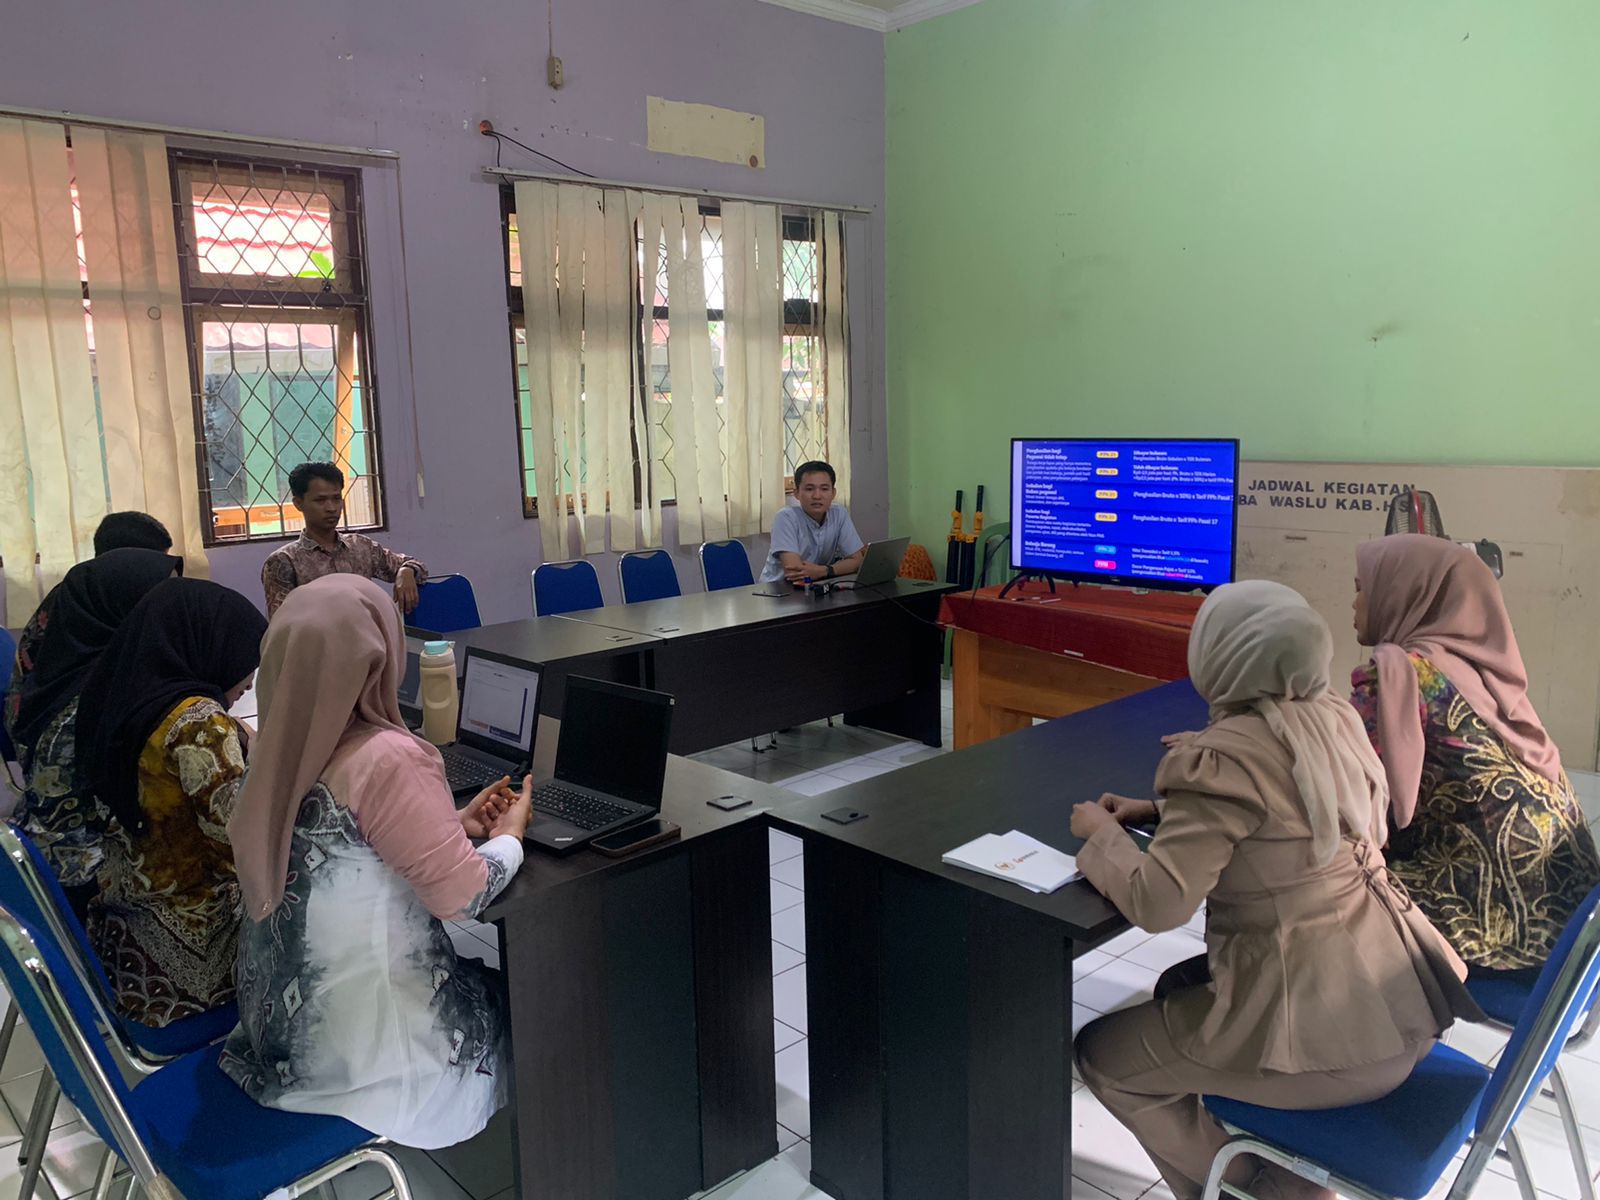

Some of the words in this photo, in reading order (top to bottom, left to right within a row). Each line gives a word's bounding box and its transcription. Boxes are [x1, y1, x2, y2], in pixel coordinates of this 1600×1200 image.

[1248, 480, 1314, 493] JADWAL
[1324, 482, 1415, 496] KEGIATAN
[1238, 494, 1258, 506] BA
[1270, 496, 1327, 510] WASLU
